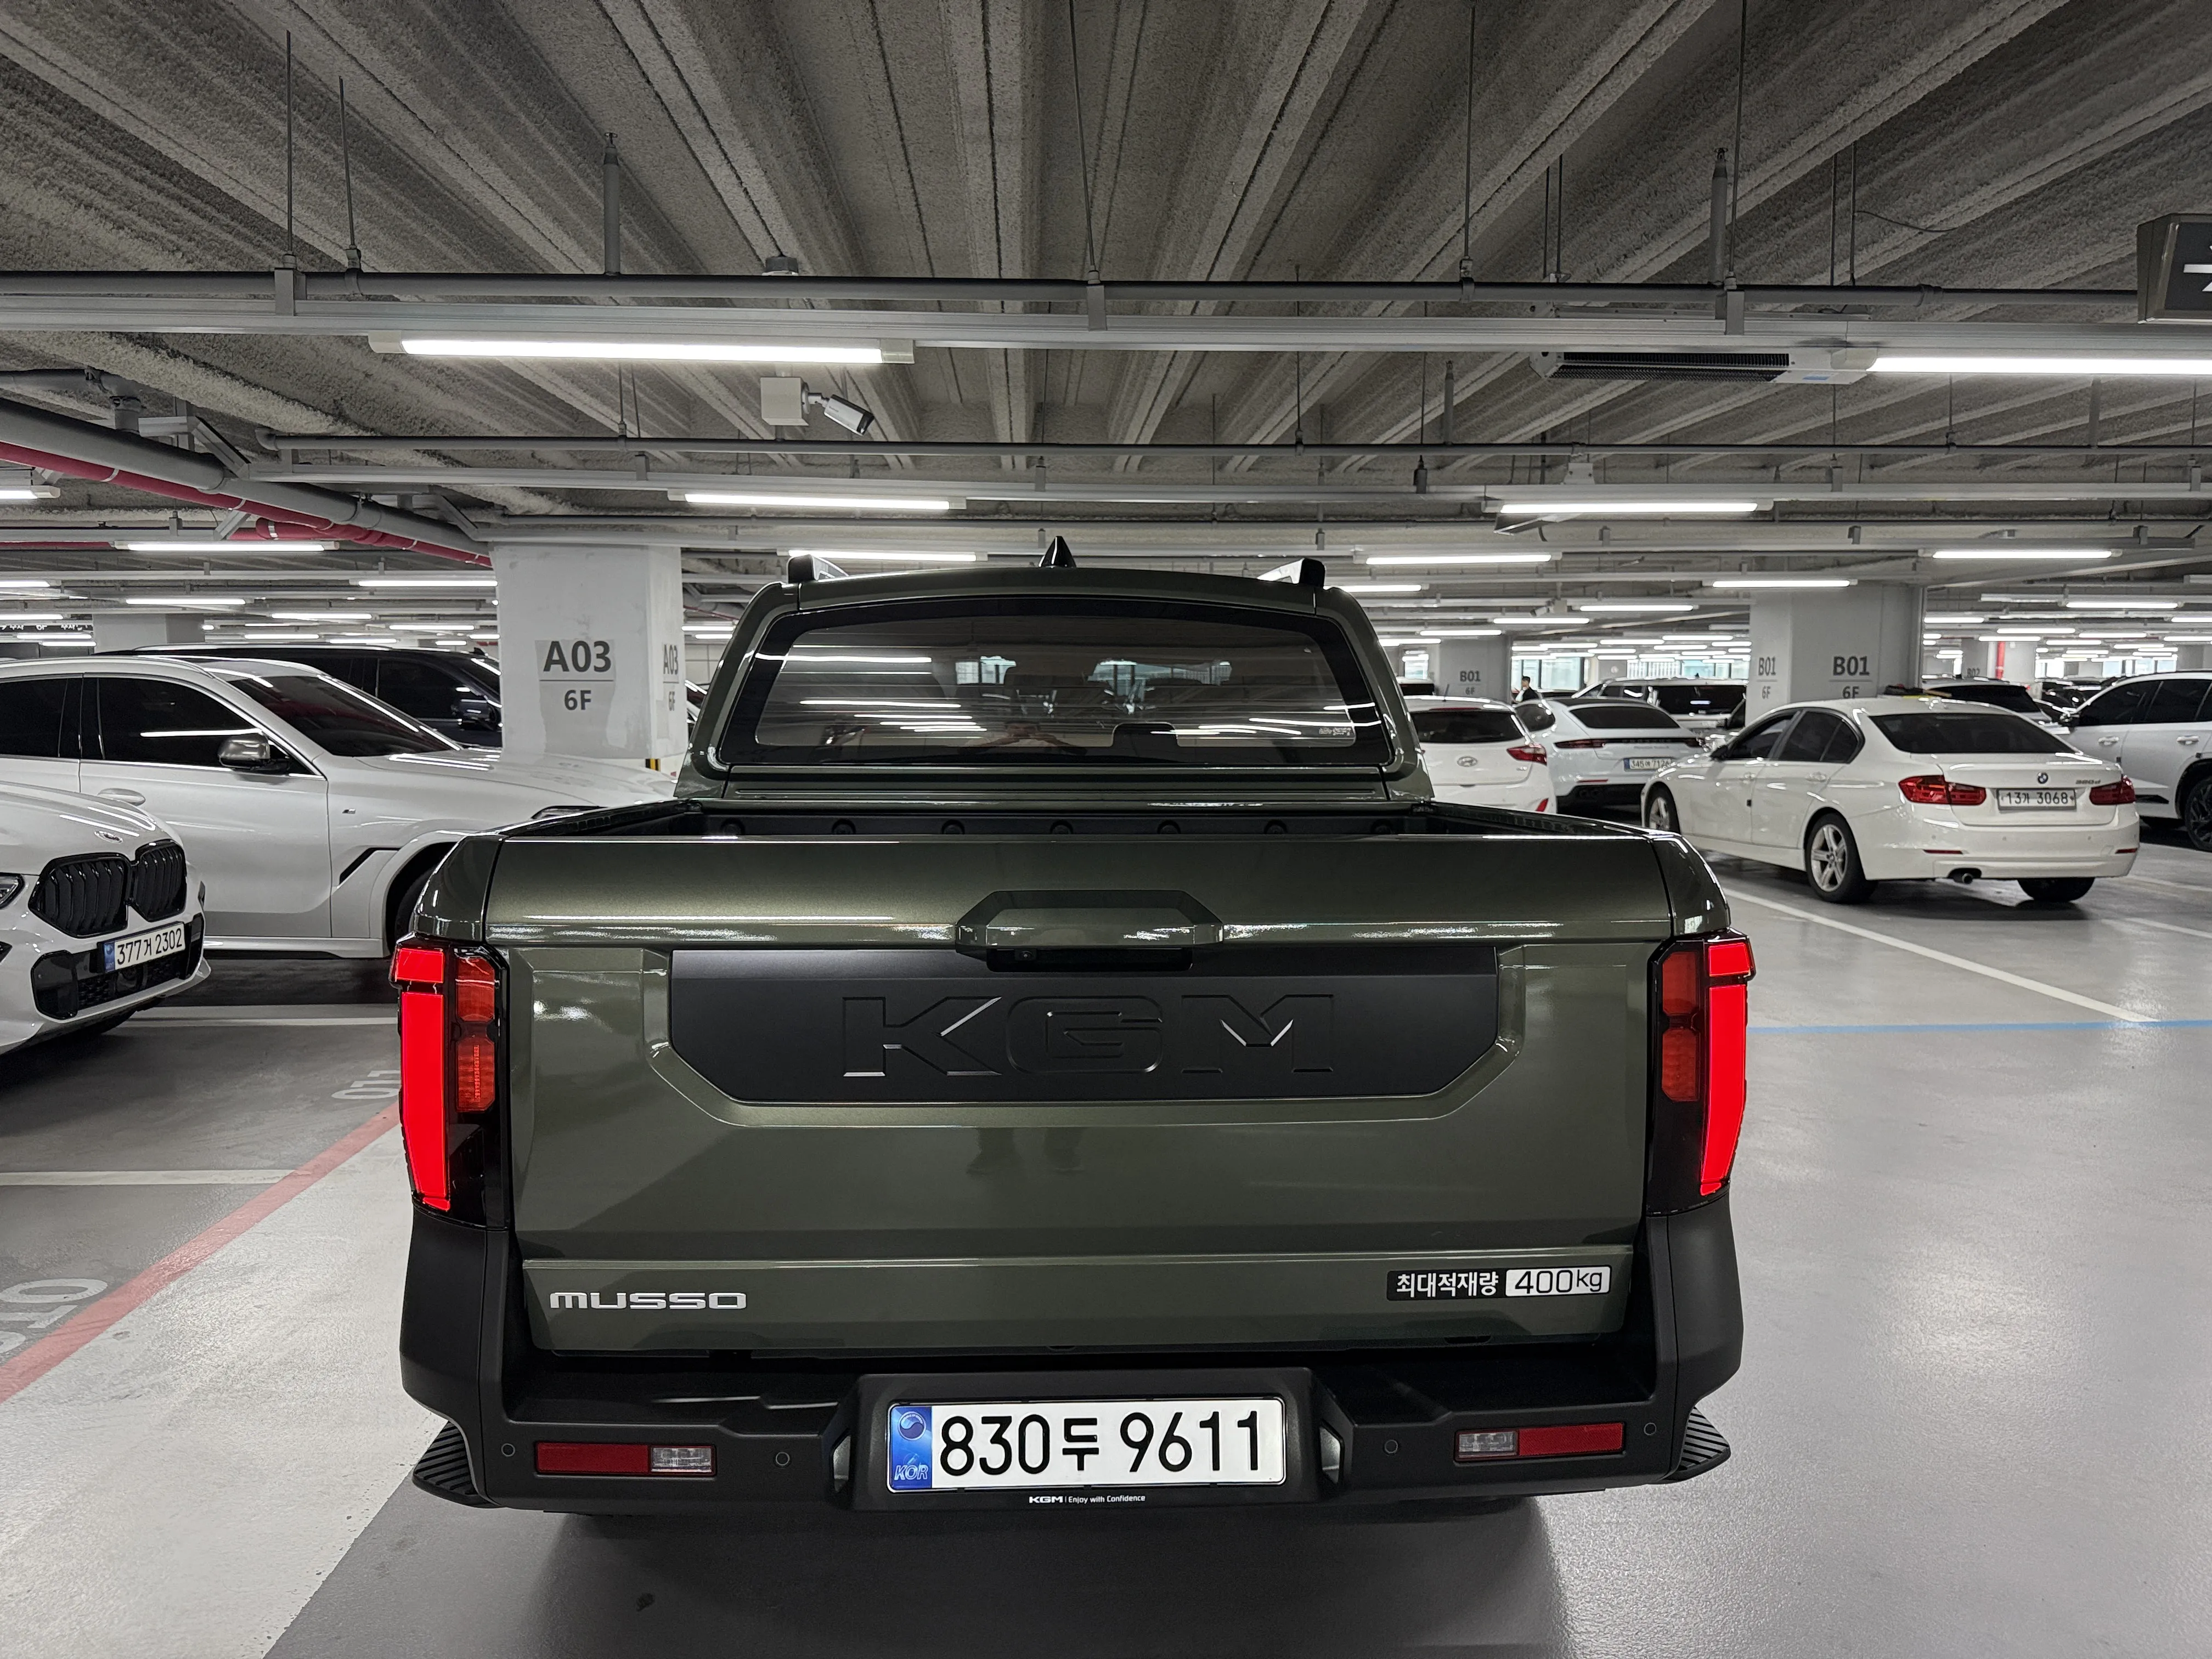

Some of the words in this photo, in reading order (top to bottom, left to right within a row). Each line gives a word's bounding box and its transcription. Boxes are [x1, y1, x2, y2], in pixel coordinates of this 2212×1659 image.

[543, 641, 611, 672] A03
[663, 644, 679, 675] A03
[1758, 657, 1776, 676] B01
[1833, 656, 1870, 676] B01
[1460, 670, 1481, 682] B01
[565, 690, 591, 710] 6F
[668, 691, 675, 711] 6F
[1762, 686, 1771, 699] 6F
[1842, 686, 1859, 698] 6F
[2006, 792, 2030, 804] 13가
[2036, 792, 2068, 804] 3068
[117, 938, 152, 965] 377거
[155, 928, 182, 955] 2302
[843, 994, 1335, 1076] KGM
[1396, 1272, 1499, 1298] 최대적재량
[1515, 1269, 1602, 1295] 400kg
[550, 1292, 747, 1309] MUSSO
[940, 1415, 1099, 1476] 830두
[1120, 1410, 1259, 1472] 9611
[894, 1463, 929, 1481] KOR
[1029, 1496, 1063, 1504] KGM
[1068, 1496, 1088, 1504] Enjoy
